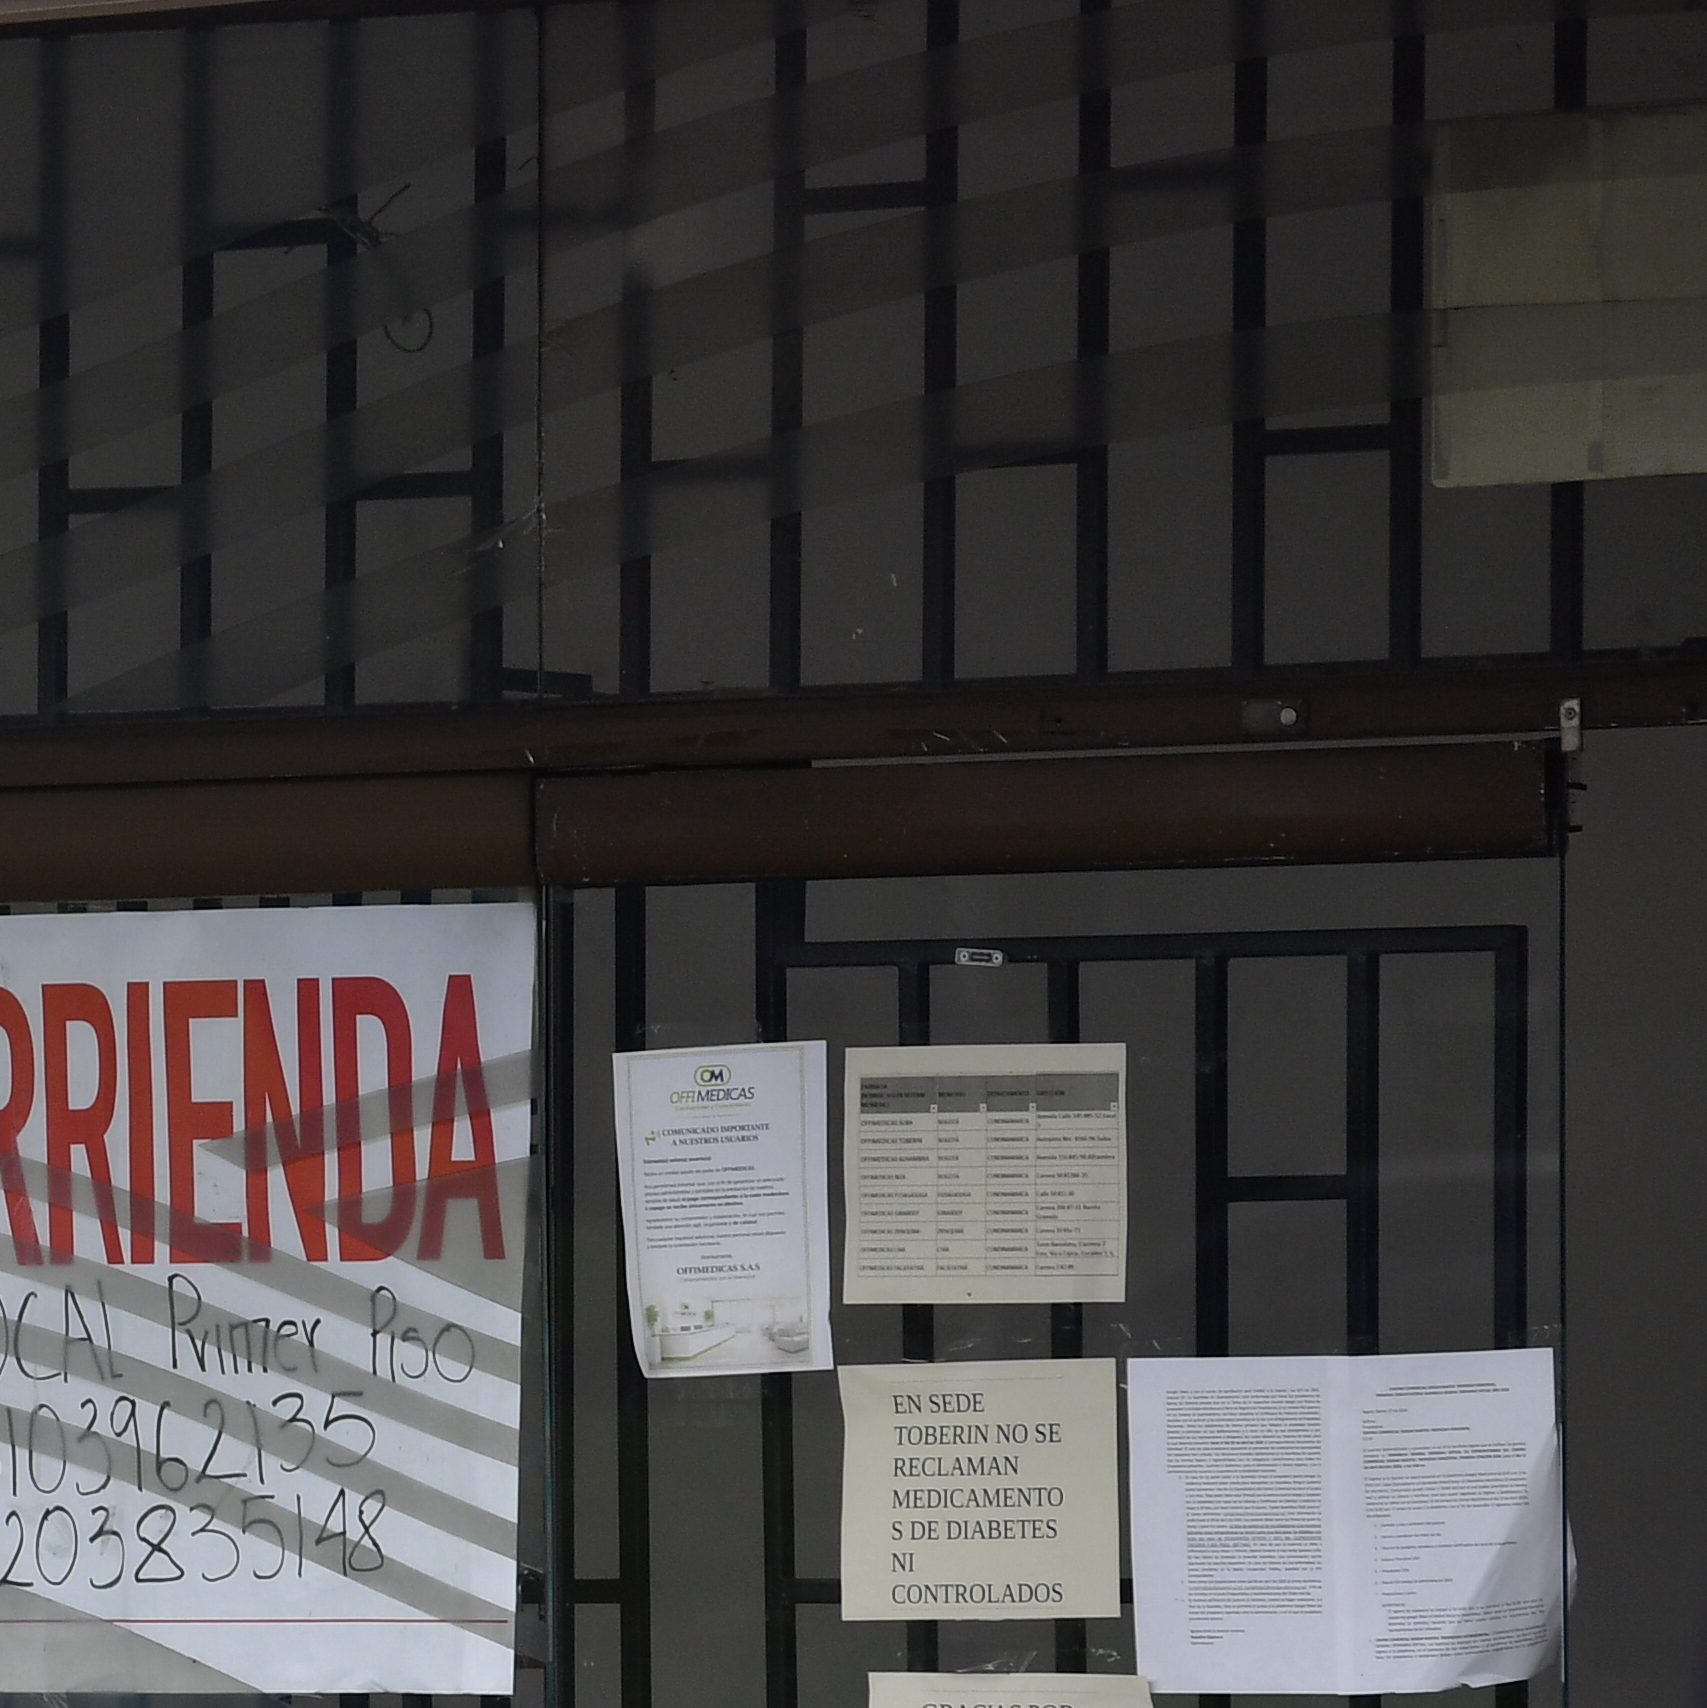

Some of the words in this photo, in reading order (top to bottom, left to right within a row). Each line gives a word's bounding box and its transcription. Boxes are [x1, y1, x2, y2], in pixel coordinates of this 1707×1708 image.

[669, 1086, 756, 1105] OFFIMEDICAS
[662, 1125, 719, 1137] COMUNICADO
[721, 1123, 770, 1133] IMPORTANTE
[679, 1137, 719, 1146] NUESTROS
[721, 1135, 759, 1144] USUARIOS
[893, 1394, 922, 1414] EN
[929, 1393, 985, 1413] SEDE
[894, 1424, 989, 1446] TOBERIN
[995, 1424, 1028, 1444] NO
[1035, 1423, 1062, 1443] SE
[893, 1455, 1020, 1477] RECLAMAN
[891, 1487, 1064, 1509] MEDICAMENTO
[891, 1521, 903, 1541] S
[910, 1520, 940, 1540] DE
[946, 1519, 1058, 1540] DIABETES
[891, 1553, 915, 1573] NI
[891, 1583, 1064, 1604] CONTROLADOS
